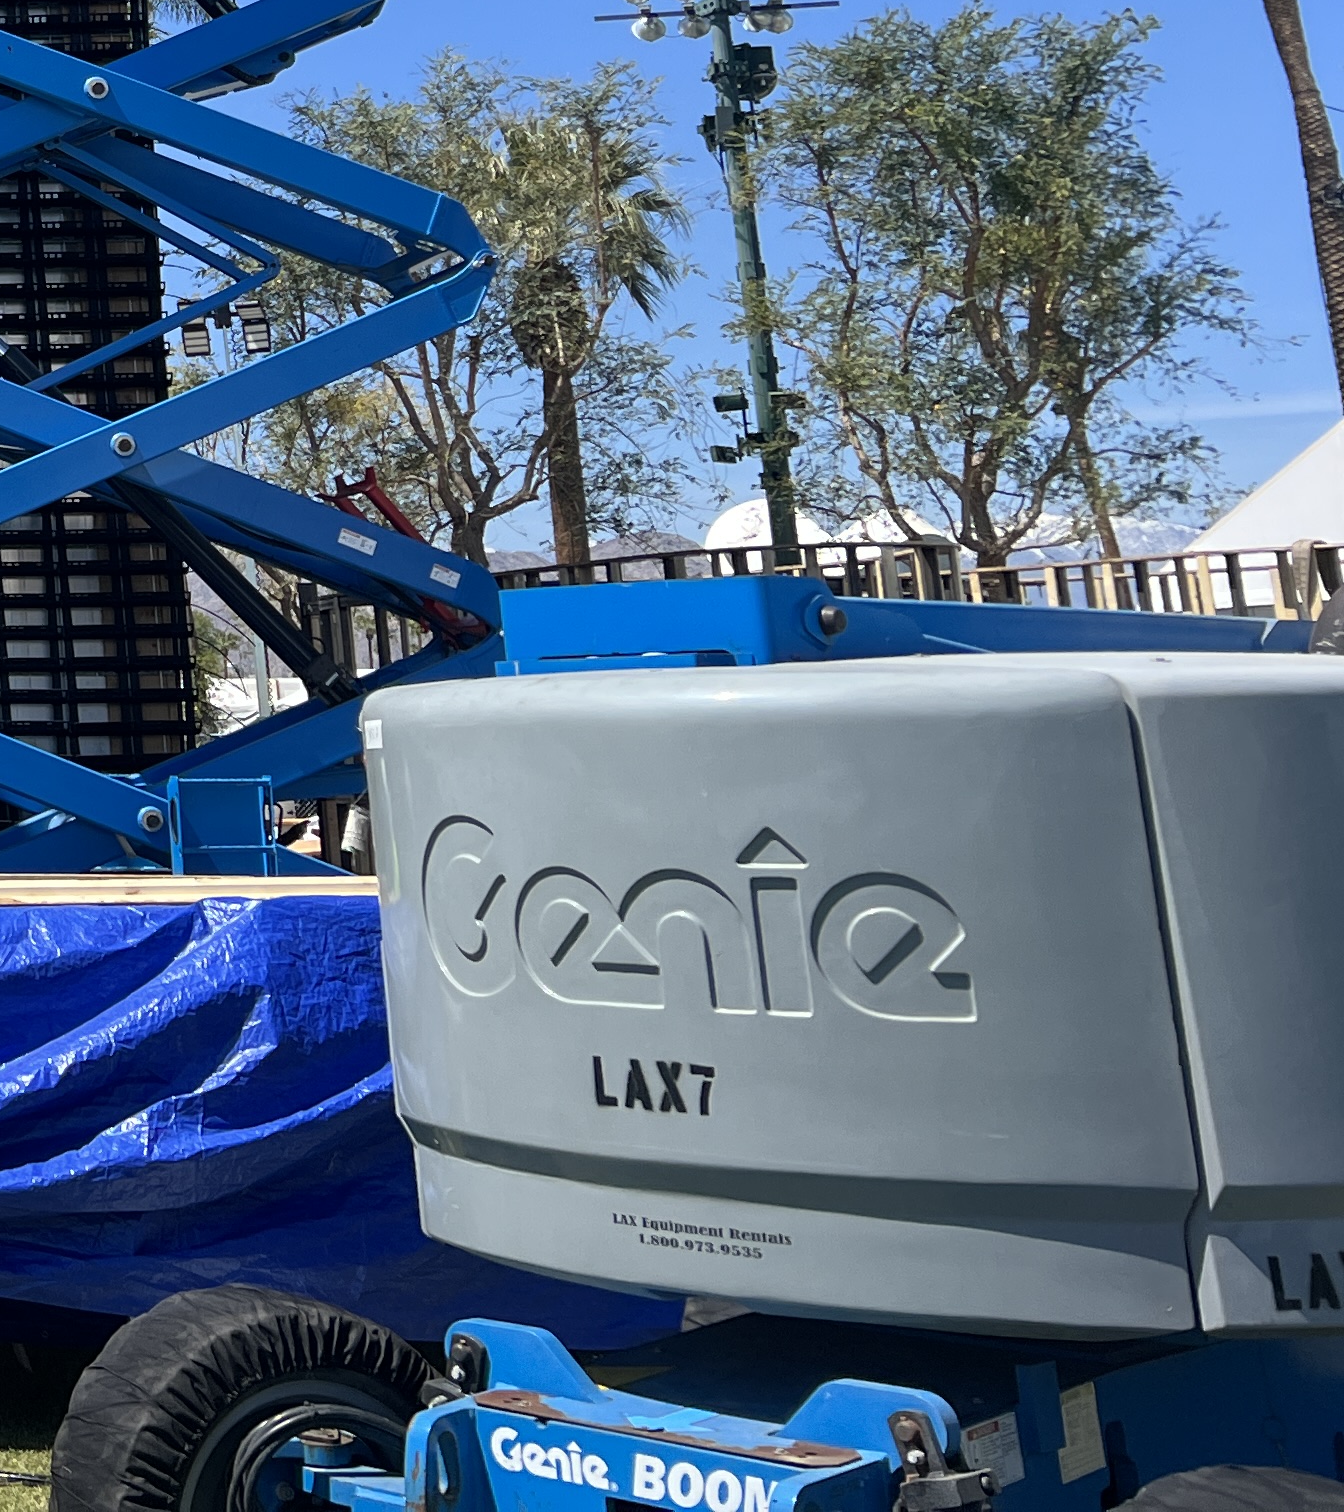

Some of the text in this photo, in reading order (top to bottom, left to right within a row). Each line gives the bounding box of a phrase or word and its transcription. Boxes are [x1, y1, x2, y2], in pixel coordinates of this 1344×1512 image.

[421, 813, 978, 1024] Genie
[591, 1054, 716, 1117] LAX7
[612, 1212, 792, 1246] LAX Equipment Rentals
[638, 1233, 763, 1260] 1.800.973.9535
[1267, 1251, 1344, 1311] LA
[490, 1426, 612, 1491] Genie
